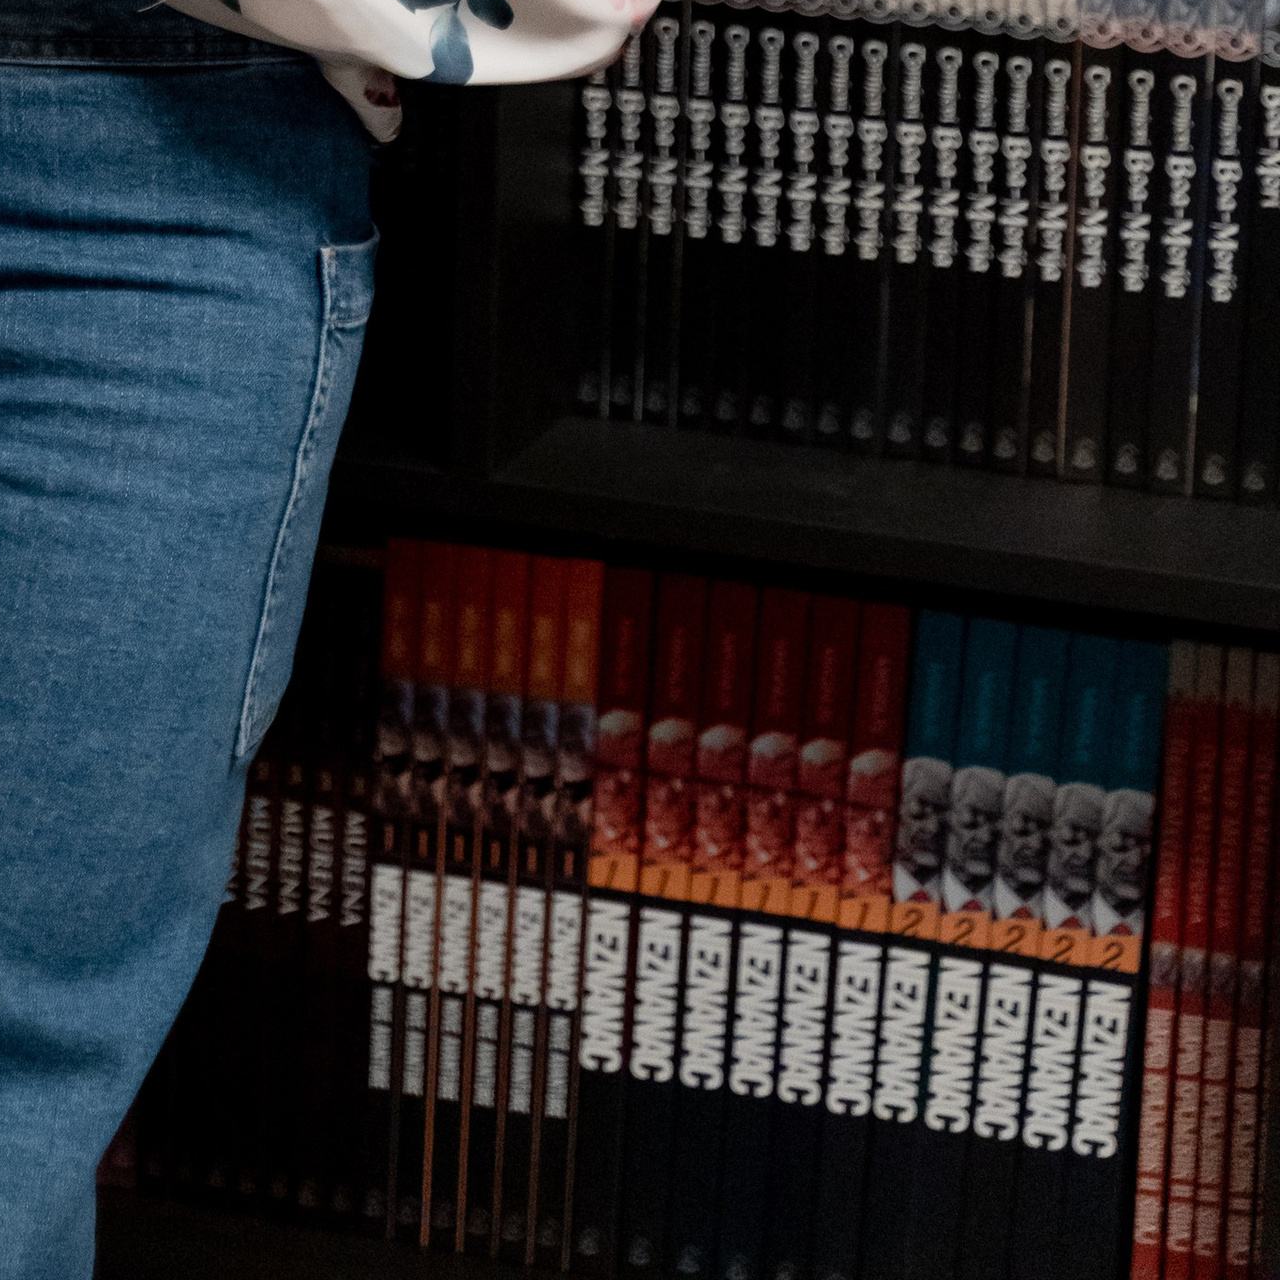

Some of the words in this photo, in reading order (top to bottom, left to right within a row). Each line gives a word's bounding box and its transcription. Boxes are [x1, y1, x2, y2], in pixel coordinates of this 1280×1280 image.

[648, 96, 679, 235] Boa-Morija
[683, 99, 715, 239] Boa-Morija
[718, 104, 750, 244] Boa-Morija
[752, 107, 785, 247] Boa-Morija
[787, 111, 819, 252] Boa-Morija
[821, 114, 854, 256] Boa-Morija
[855, 118, 888, 261] Boa-Morija
[891, 121, 926, 264] Boa-Morija
[928, 125, 963, 268] Boa-Morija
[965, 130, 1000, 273] Boa-Morija
[998, 134, 1033, 278] Boa-Morija
[1037, 138, 1071, 282] Boa-Morija
[1077, 144, 1111, 288] Boa-Morija
[1119, 148, 1155, 293] Boa-Morija
[1161, 153, 1198, 299] Boa-Morija
[1208, 157, 1244, 304] Boa-Morija
[245, 796, 271, 911] MURENA
[277, 800, 304, 916] MURENA
[307, 805, 335, 923] MURENA
[339, 810, 368, 927] MURENA
[901, 908, 923, 934] 2
[578, 897, 631, 1074] NEZNANAC
[629, 905, 683, 1083] NEZNANAC
[953, 917, 974, 942] 2
[1002, 925, 1025, 951] 2
[1053, 934, 1074, 961] 2
[1101, 941, 1124, 968] 2
[679, 913, 732, 1091] NEZNANAC
[729, 921, 783, 1099] NEZNANAC
[777, 929, 831, 1107] NEZNANAC
[826, 940, 881, 1117] NEZNANAC
[873, 946, 931, 1124] NEZNANAC
[924, 955, 983, 1134] NEZNANAC
[973, 962, 1033, 1142] NEZNANAC
[1022, 972, 1082, 1152] NEZNANAC
[1071, 979, 1132, 1159] NEZNANAC
